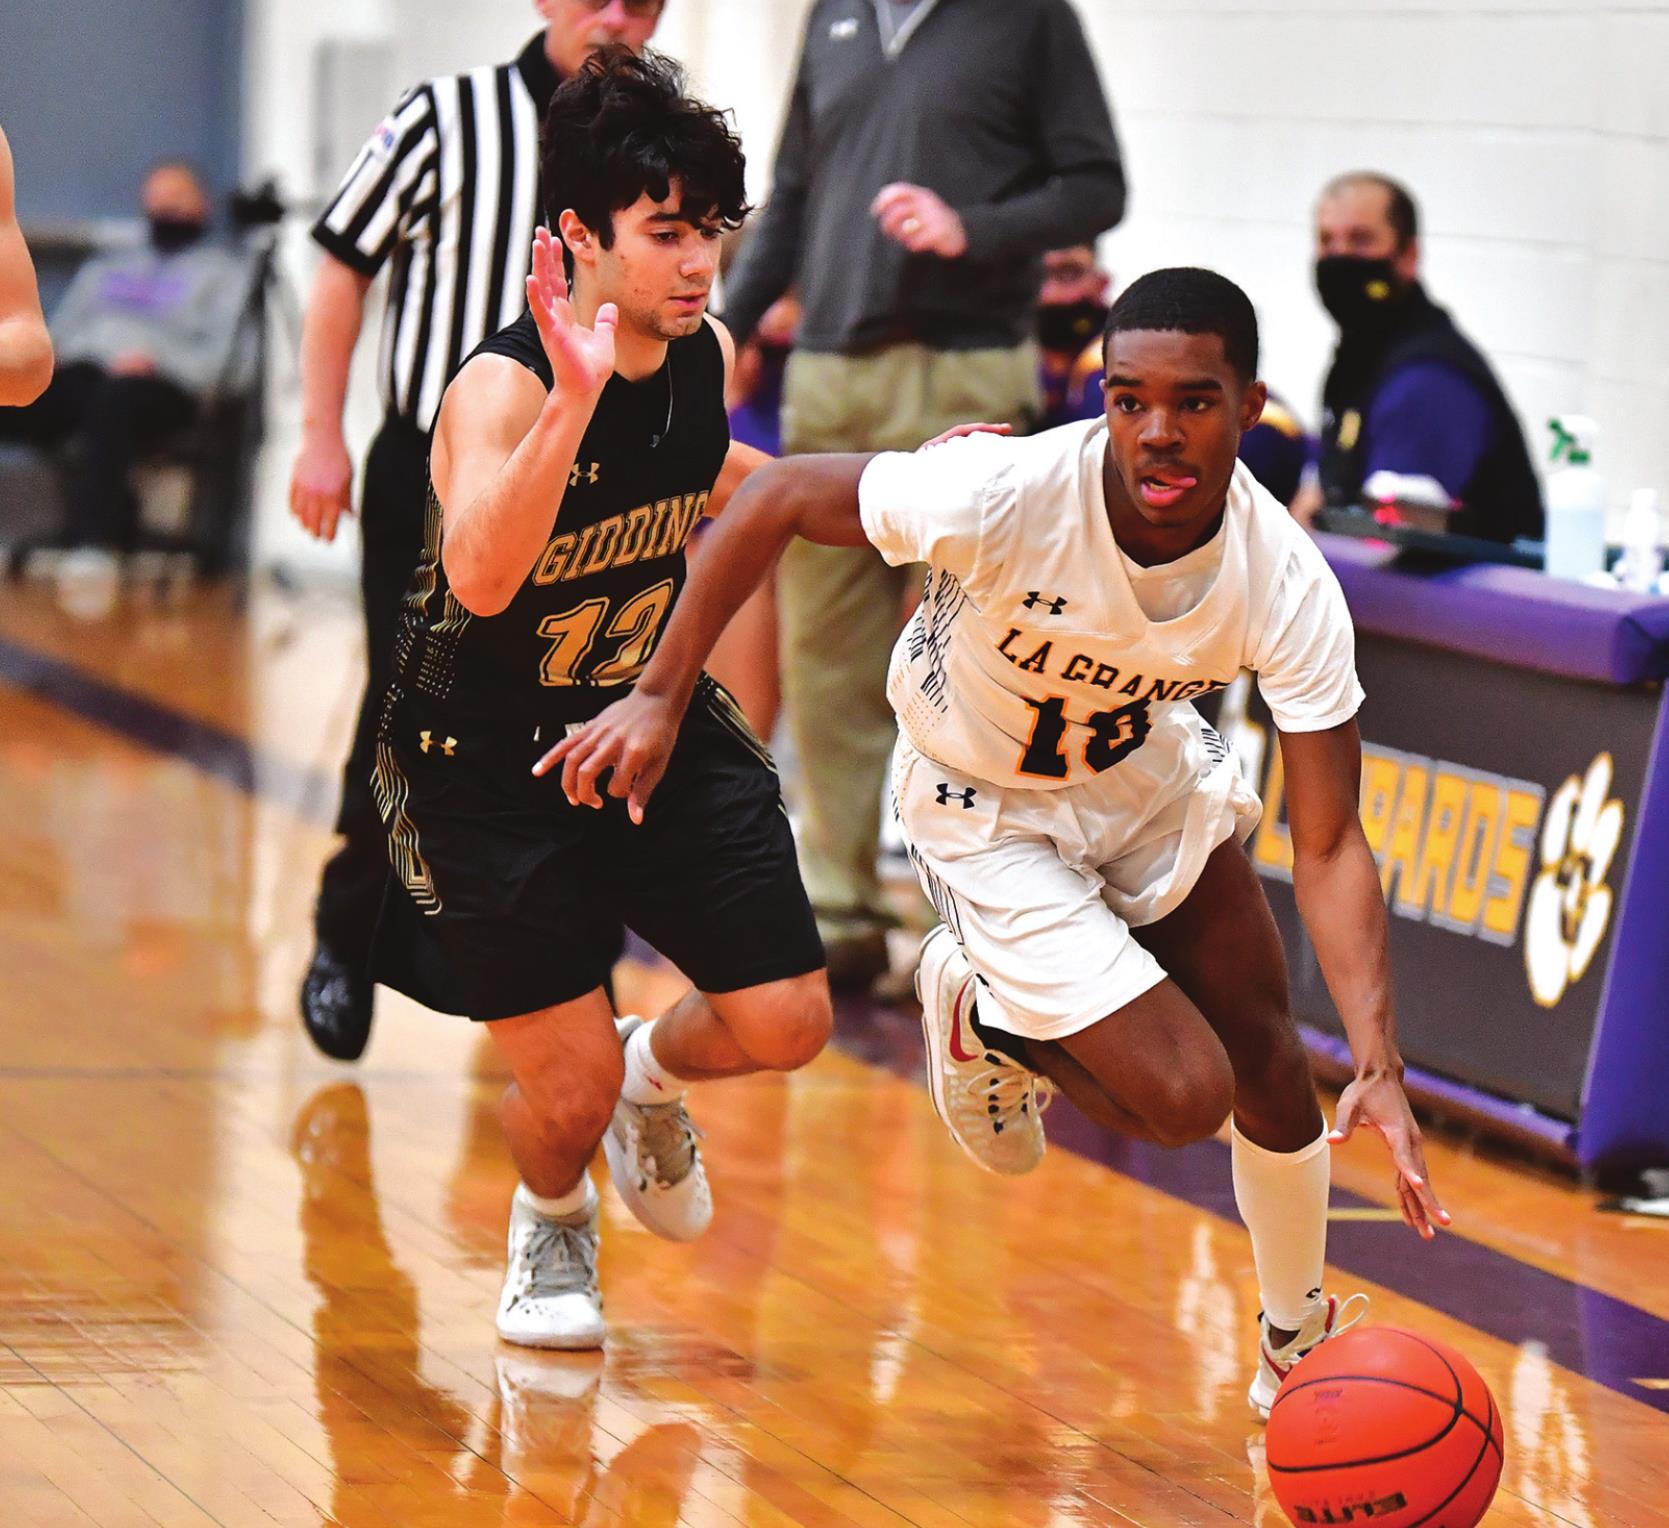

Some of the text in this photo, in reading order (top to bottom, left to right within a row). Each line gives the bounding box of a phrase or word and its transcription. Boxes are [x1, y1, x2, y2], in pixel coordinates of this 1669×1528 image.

[536, 577, 674, 687] 12
[996, 627, 1053, 675] LA
[1014, 691, 1153, 783] 10
[1251, 728, 1547, 948] LPARDS
